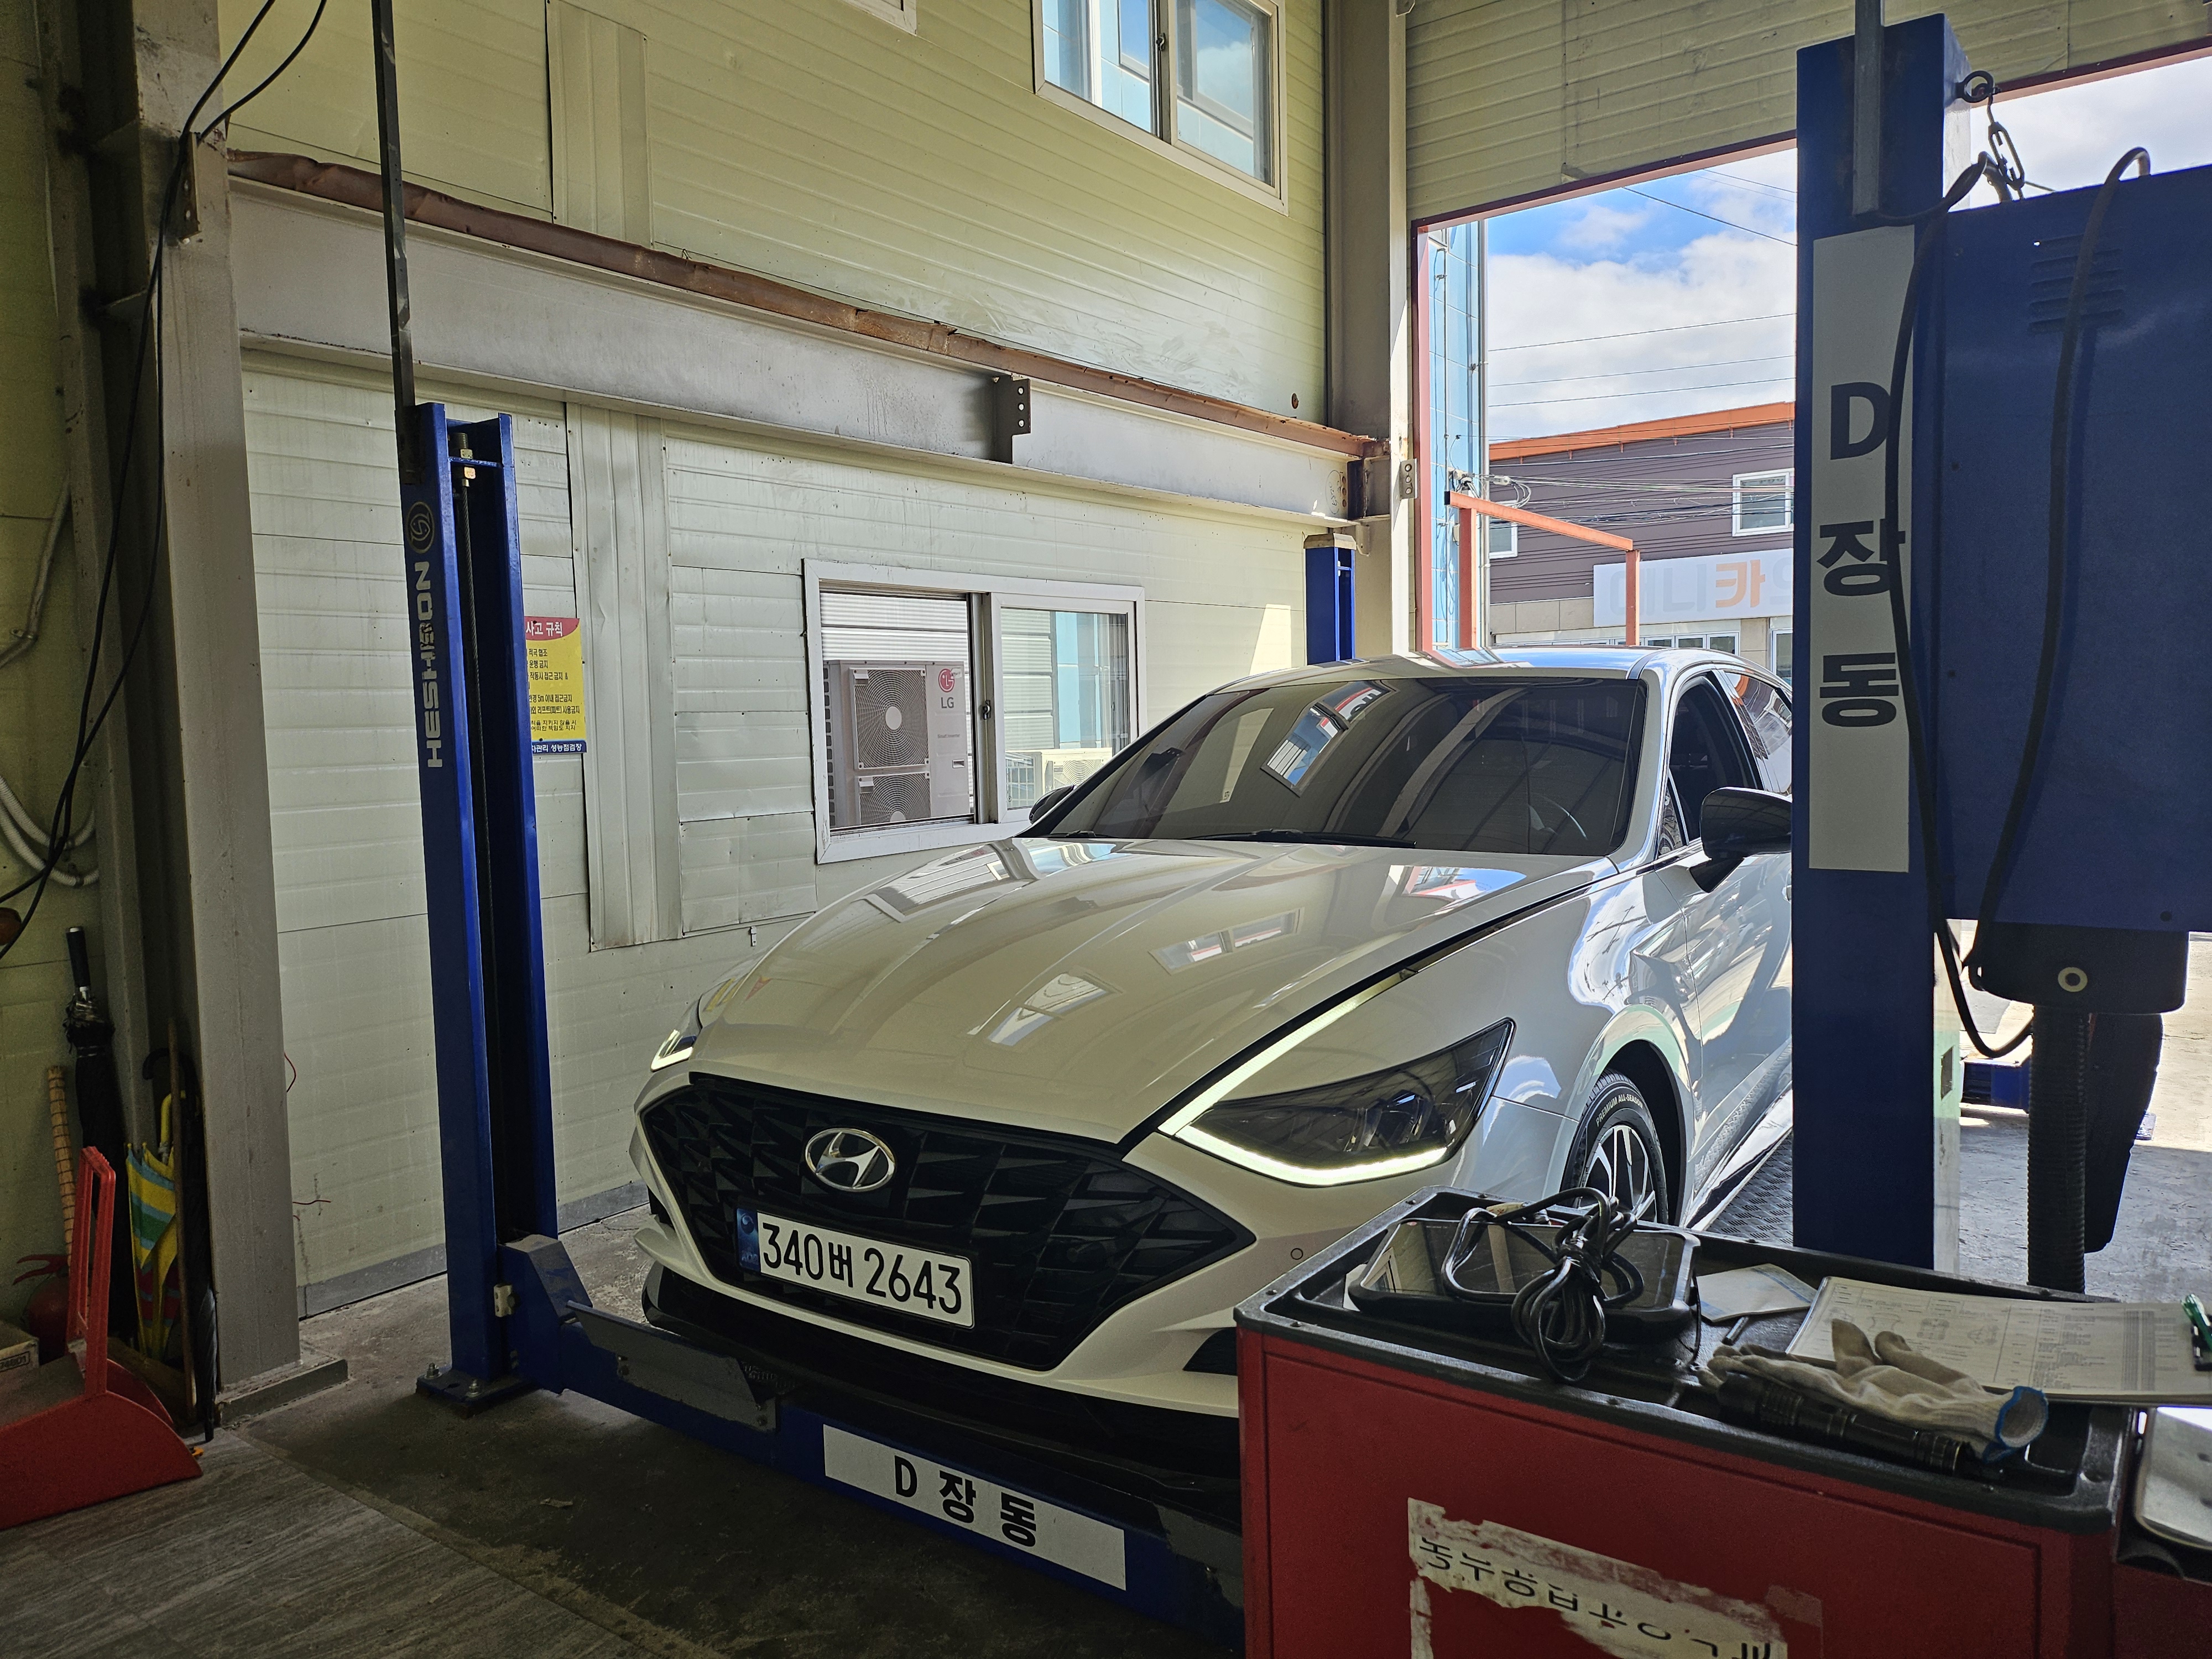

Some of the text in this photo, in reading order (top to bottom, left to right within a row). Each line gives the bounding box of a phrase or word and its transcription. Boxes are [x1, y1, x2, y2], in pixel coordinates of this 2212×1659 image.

[546, 622, 562, 637] 규칙
[529, 660, 548, 669] 운행 금지
[545, 694, 554, 702] 이내
[941, 697, 954, 708] LG
[1595, 1093, 1644, 1128] PREMIUM ALL-SEASON
[762, 1222, 962, 1314] 340버 2643
